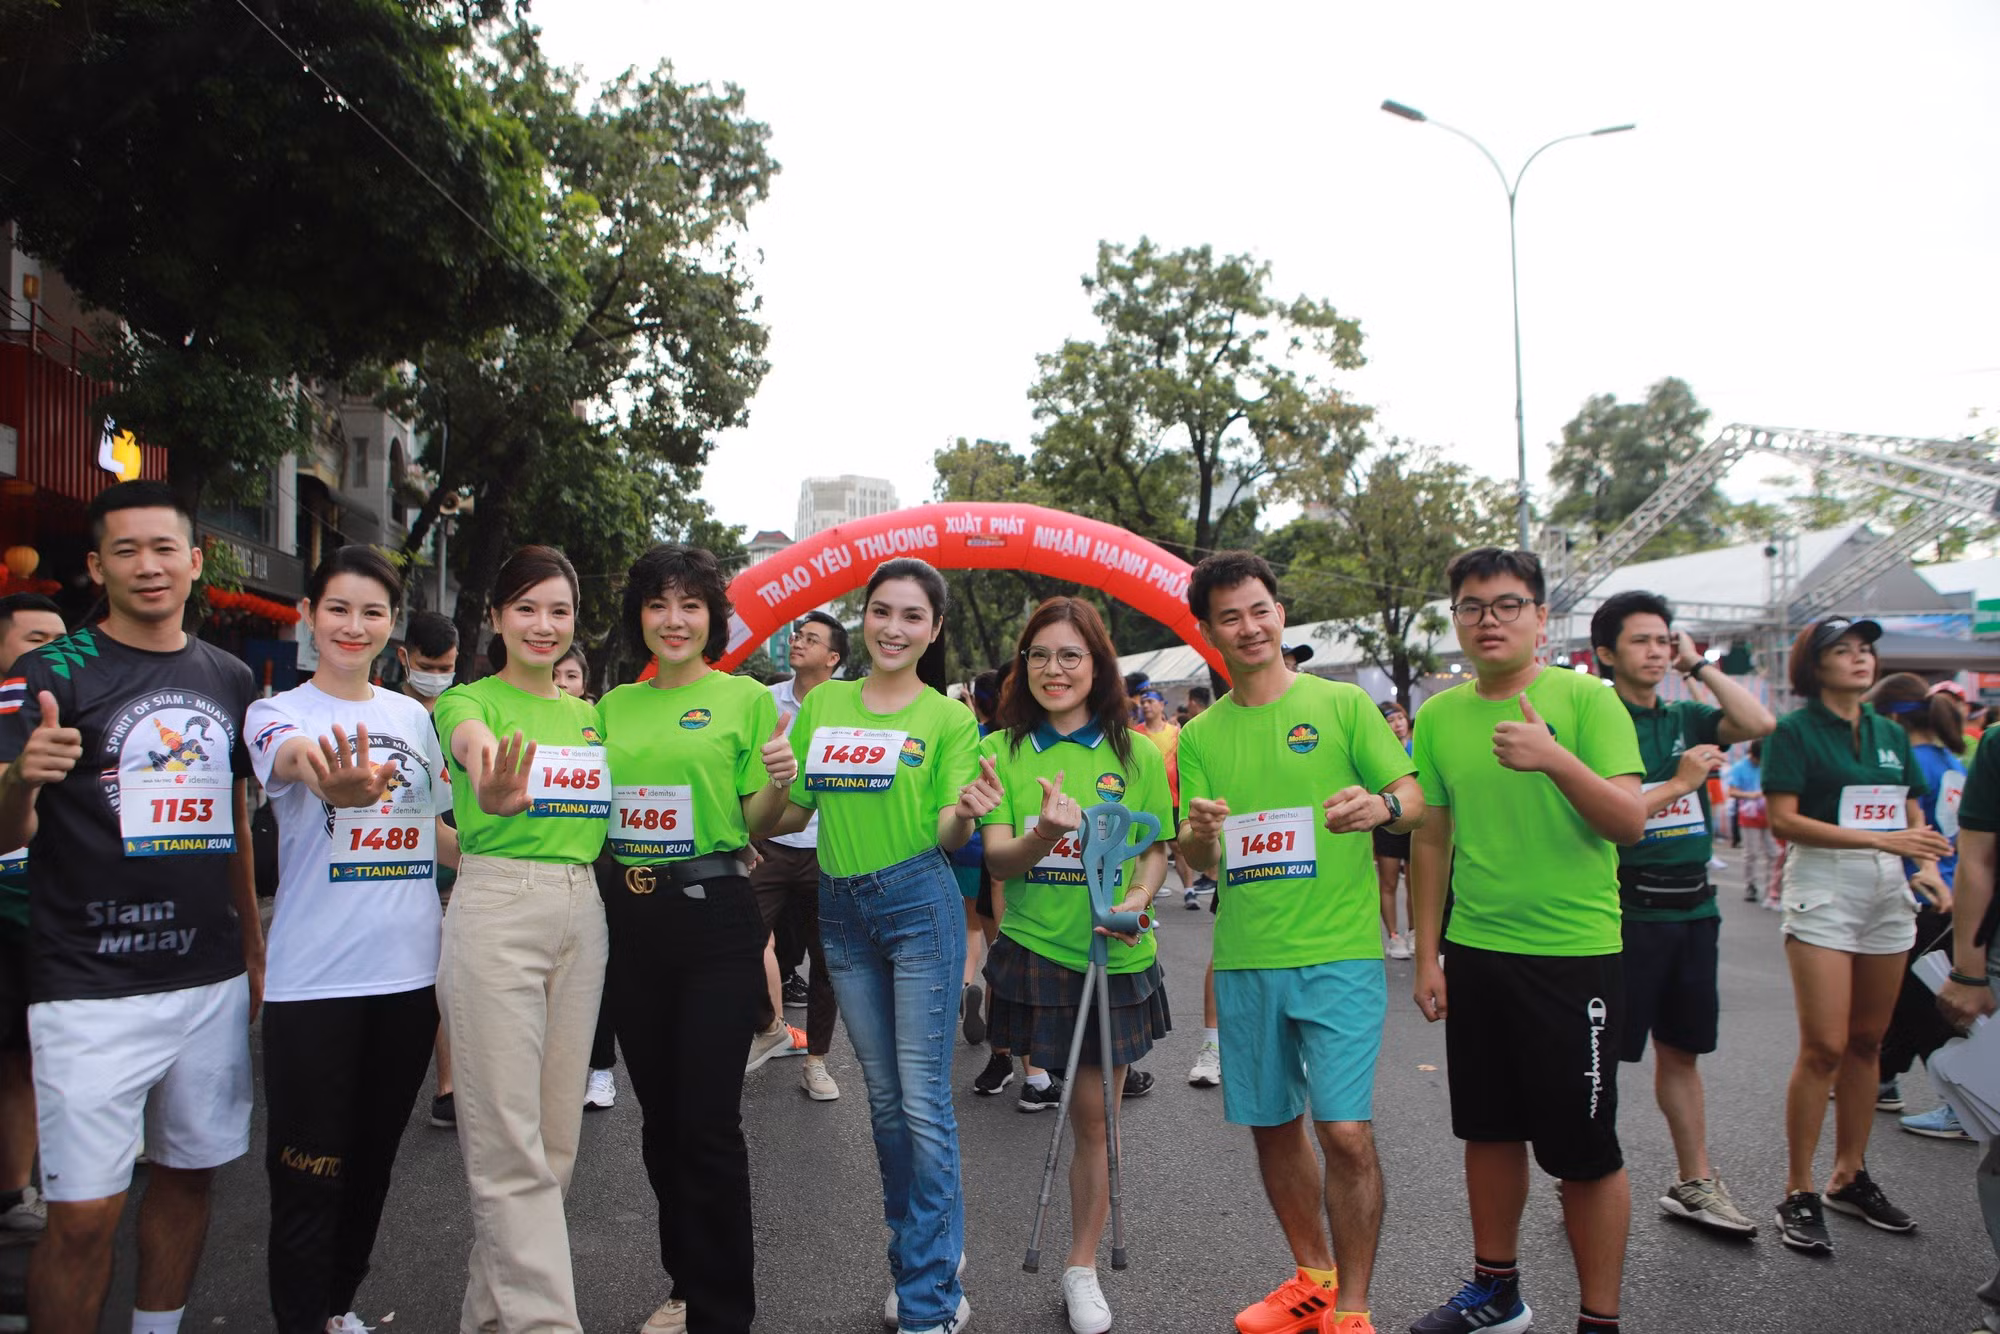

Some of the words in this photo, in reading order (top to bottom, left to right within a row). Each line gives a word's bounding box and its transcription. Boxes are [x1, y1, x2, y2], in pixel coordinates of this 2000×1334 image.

[989, 514, 1026, 536] PHÁT
[1033, 525, 1092, 558] NHẬN
[1092, 540, 1150, 578] HẠNH
[756, 565, 812, 608] TRAO
[809, 544, 852, 579] YÊU
[854, 524, 939, 561] THƯƠNG
[106, 714, 134, 754] SPIRIT
[135, 701, 151, 716] OF
[152, 694, 184, 707] SIAM
[195, 699, 228, 723] MUAY
[822, 745, 886, 764] 1489
[188, 775, 219, 785] idemitsu
[543, 766, 601, 790] 1485
[869, 778, 892, 788] RUN
[647, 789, 676, 797] idemitsu
[151, 798, 214, 823] 1153
[392, 806, 422, 815] idemitsu
[589, 804, 609, 814] RUN
[619, 808, 678, 831] 1486
[1268, 812, 1298, 820] idemitsu
[206, 838, 232, 849] RUN
[349, 827, 420, 851] 1488
[665, 843, 691, 854] RUN
[1241, 831, 1296, 856] 1481
[407, 864, 431, 875] RUN
[1287, 864, 1313, 875] RUN
[85, 900, 175, 927] Siam
[96, 928, 198, 955] Muay
[1584, 997, 1607, 1119] Champion
